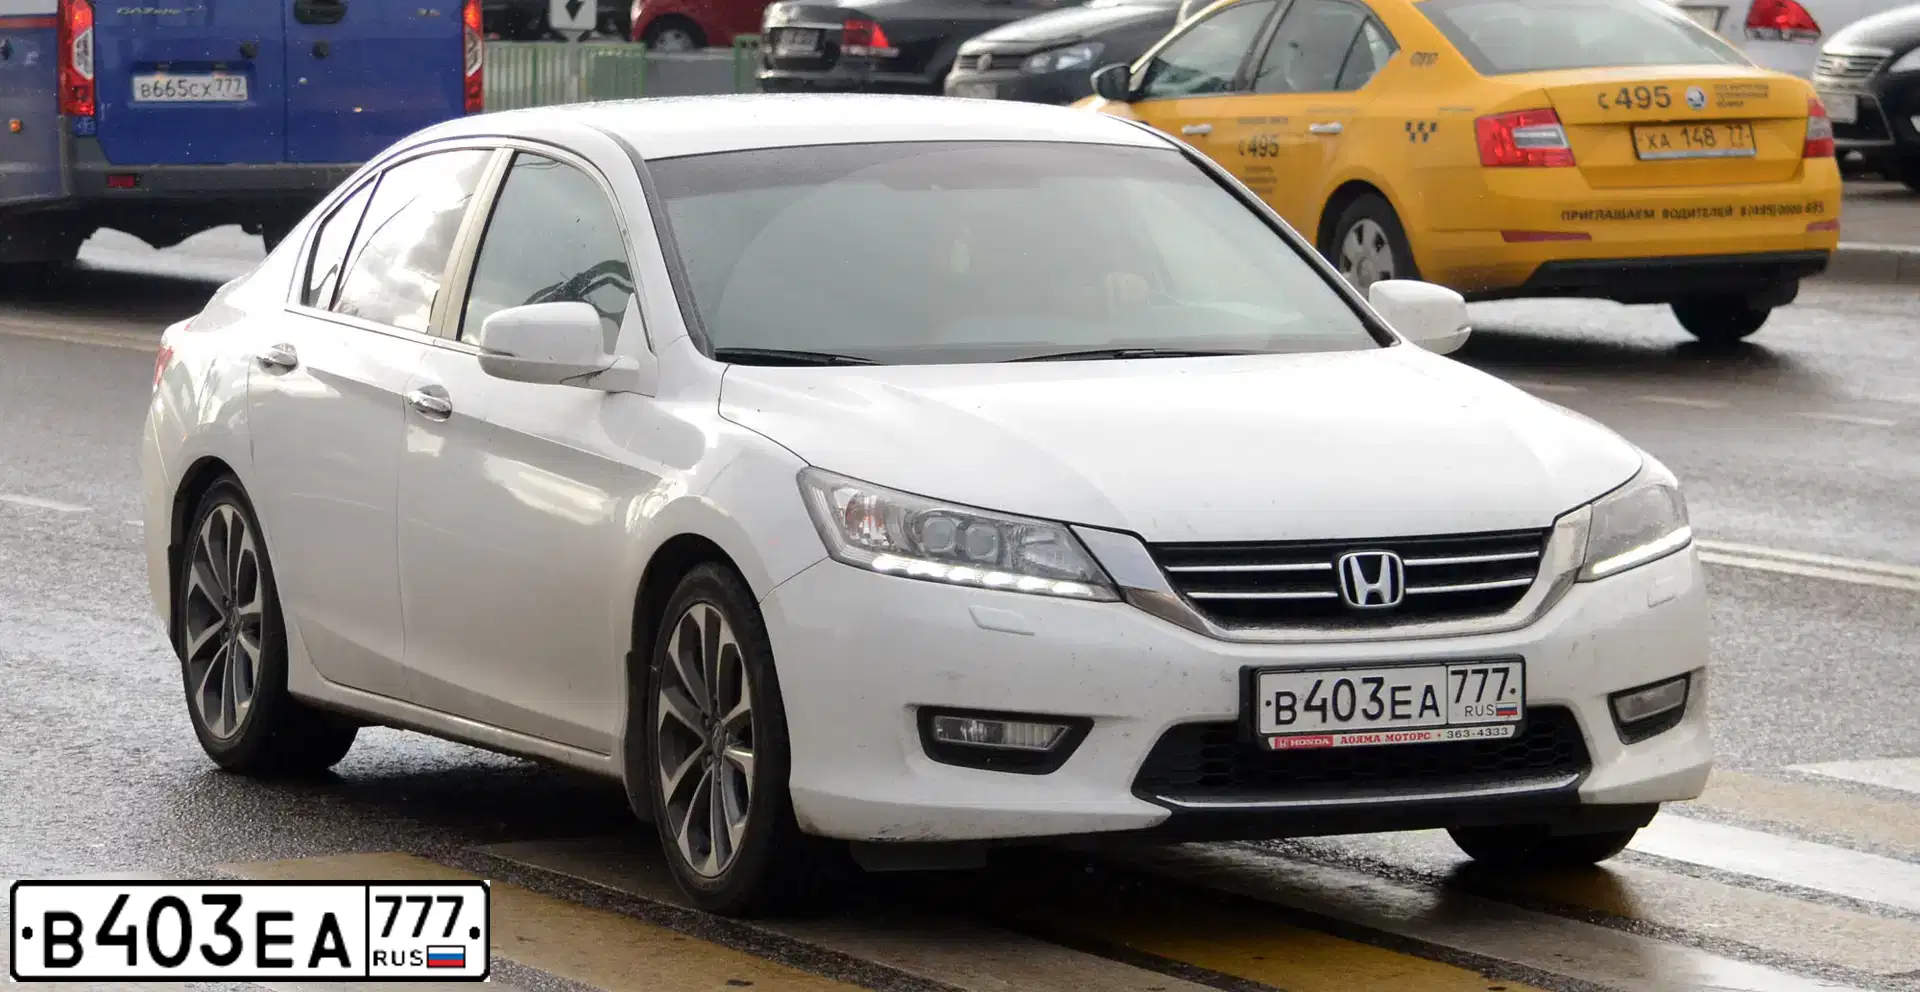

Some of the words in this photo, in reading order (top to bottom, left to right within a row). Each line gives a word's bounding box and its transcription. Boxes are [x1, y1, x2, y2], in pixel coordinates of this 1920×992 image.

[215, 78, 242, 92] 777
[1615, 86, 1672, 110] 495
[1247, 133, 1279, 158] 495
[1647, 132, 1671, 150] ХА
[1681, 126, 1717, 149] 148
[1561, 209, 1655, 221] ПРИГЛАШАЕМ
[1662, 205, 1734, 220] ВОДИТЕЛЕЙ
[1275, 676, 1440, 725] В403ЕА
[1451, 667, 1510, 703] 777
[1464, 703, 1495, 718] RUS
[1290, 738, 1331, 748] HONDA
[1340, 734, 1380, 745] АОЯМА
[1385, 731, 1432, 743] МОТОРС
[1446, 727, 1509, 739] 363-4333
